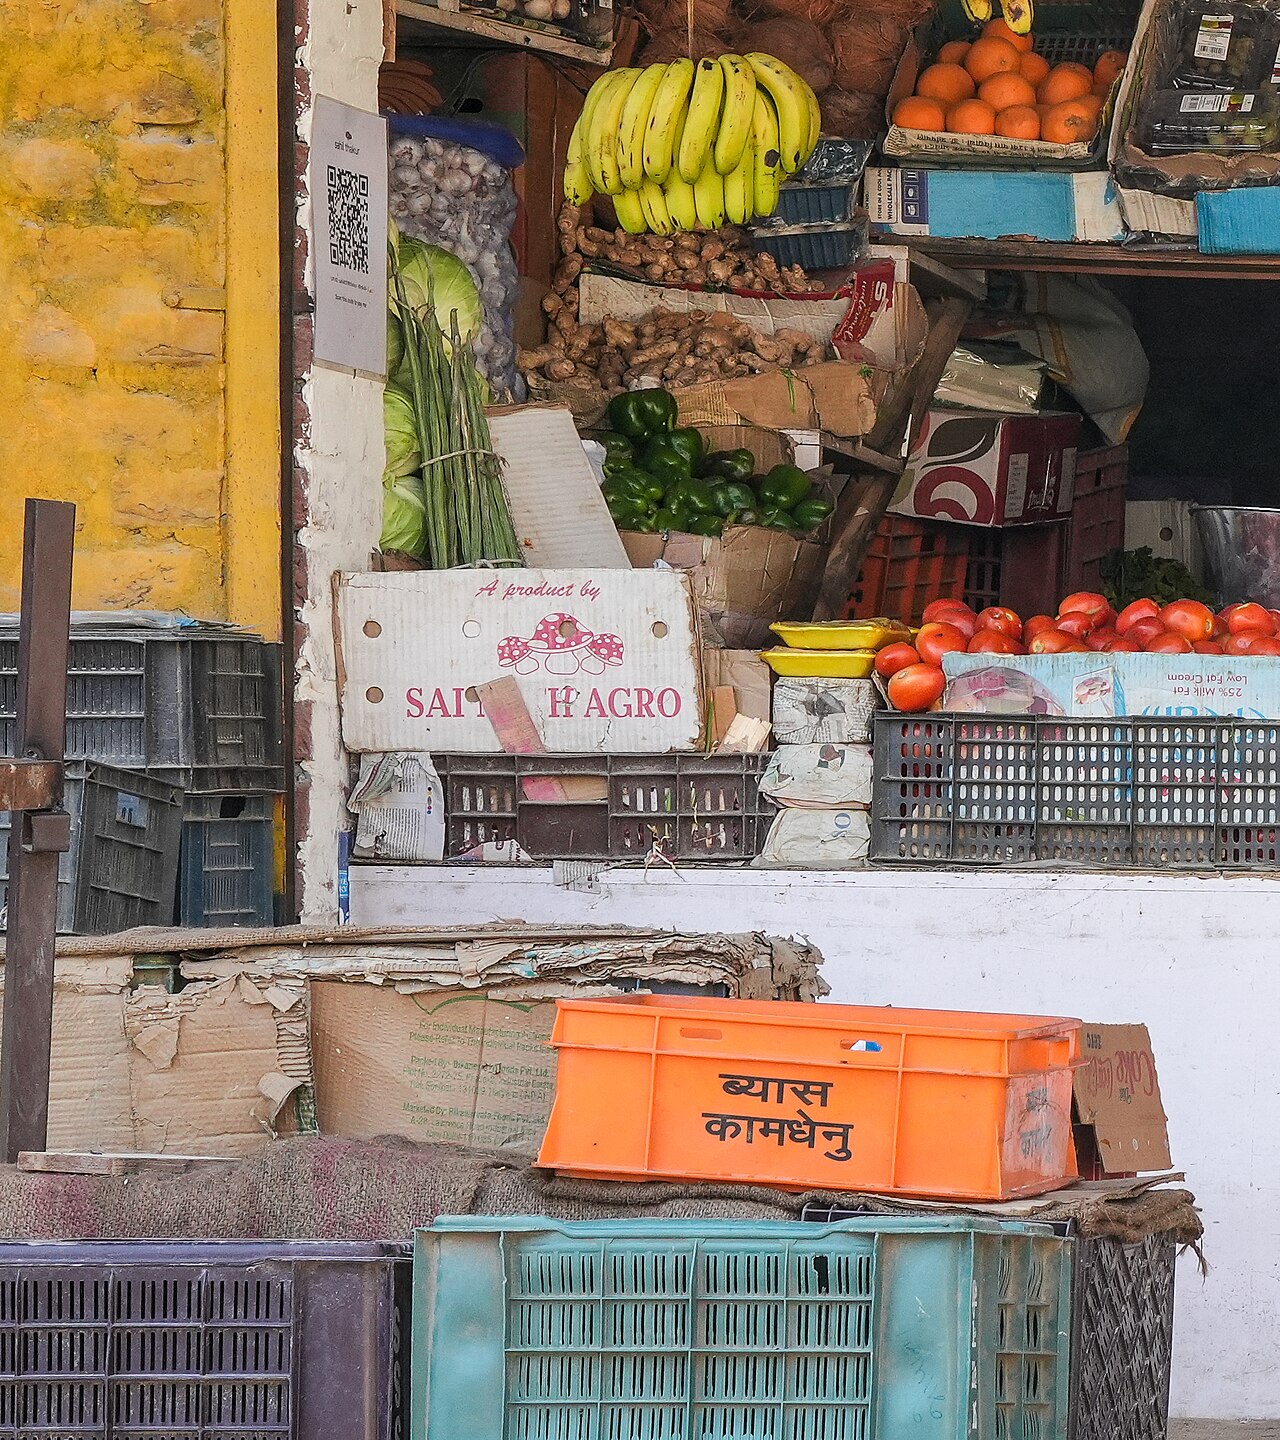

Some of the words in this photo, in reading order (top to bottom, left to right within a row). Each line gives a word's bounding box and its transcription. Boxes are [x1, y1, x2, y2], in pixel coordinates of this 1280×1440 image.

[475, 578, 497, 598] A
[502, 579, 575, 601] product
[579, 579, 602, 602] by
[1166, 673, 1204, 685] Cream
[1206, 674, 1224, 685] Fat
[1227, 674, 1249, 685] Low
[1172, 686, 1191, 696] Fat
[1192, 686, 1216, 697] Milk
[1219, 686, 1243, 698] 25%
[406, 687, 465, 719] SAI
[585, 687, 682, 719] AGRO
[718, 1072, 834, 1108] ब्यास
[701, 1109, 855, 1162] कामधेनु
